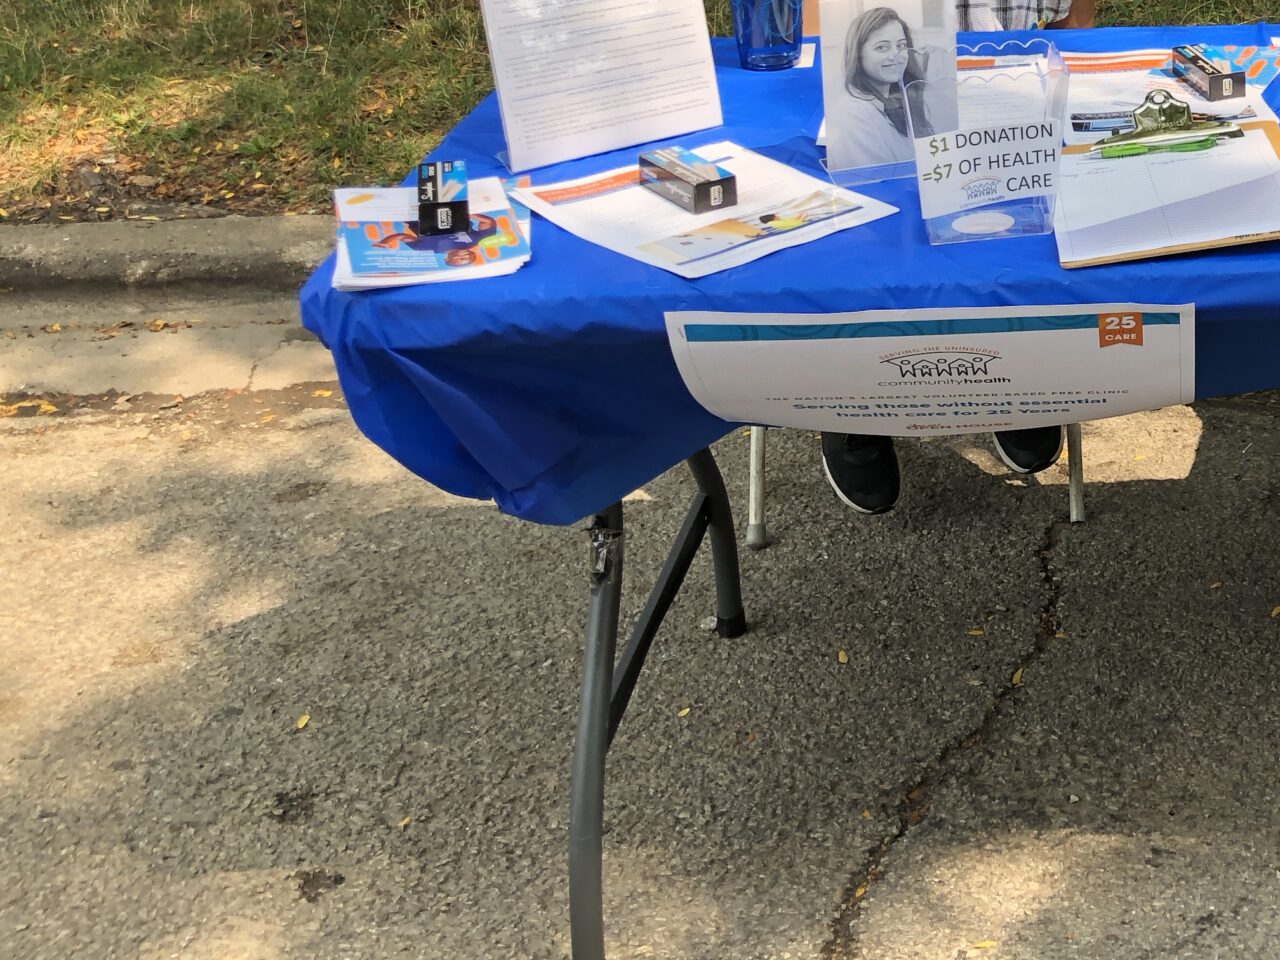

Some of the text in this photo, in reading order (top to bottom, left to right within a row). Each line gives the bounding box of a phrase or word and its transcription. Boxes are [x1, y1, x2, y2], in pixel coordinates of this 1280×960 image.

[929, 124, 1053, 157] $1 DONATION
[923, 149, 1056, 184] =$7 OF HEALTH
[1007, 174, 1052, 192] CARE
[1105, 316, 1136, 330] 25
[1105, 333, 1136, 341] CARE
[879, 348, 920, 360] SERVING
[944, 346, 1000, 356] UNINSURED
[878, 377, 1010, 387] communityhealth
[1020, 398, 1107, 406] essential
